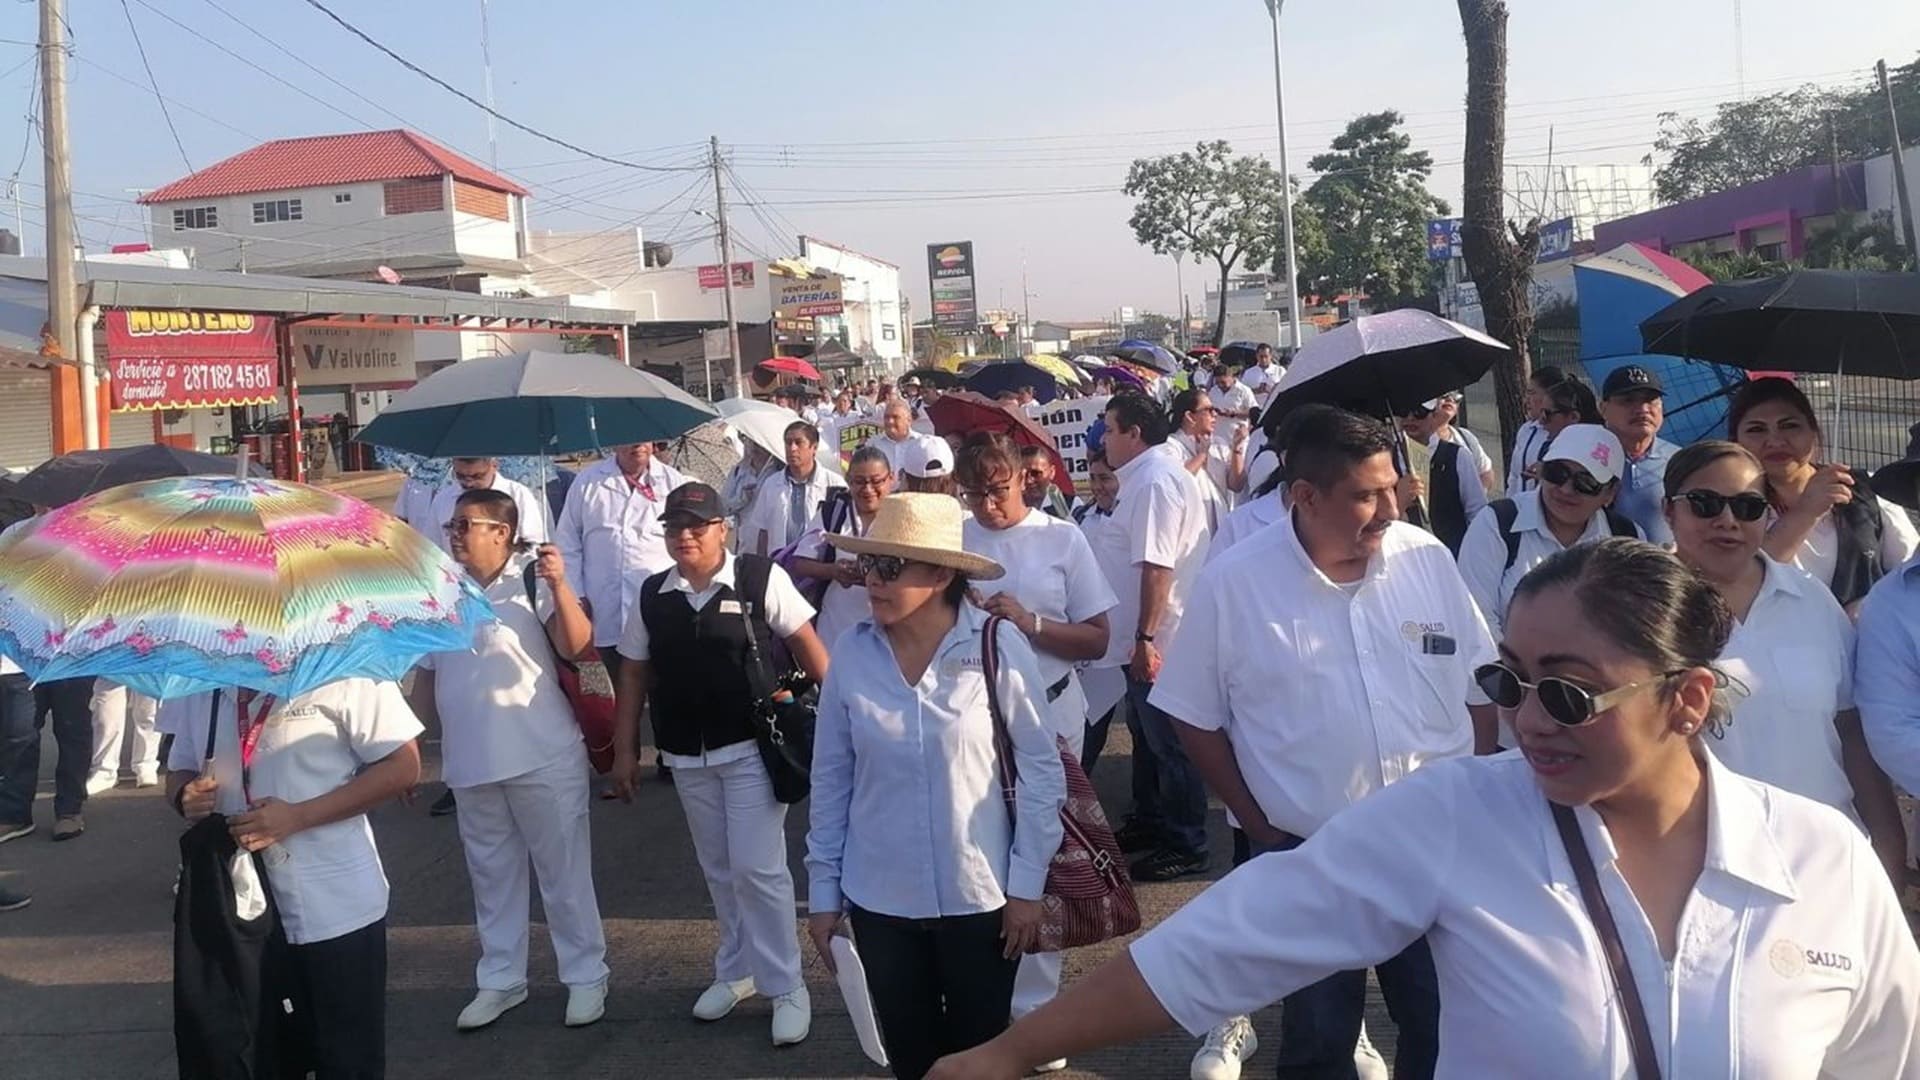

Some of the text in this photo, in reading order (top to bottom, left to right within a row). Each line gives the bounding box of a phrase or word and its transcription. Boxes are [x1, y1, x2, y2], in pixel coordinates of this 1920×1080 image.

[782, 285, 809, 293] VENTA
[328, 348, 398, 369] Valvoline
[117, 358, 164, 380] Servicio
[167, 364, 176, 379] a
[122, 380, 167, 400] domicilio
[1032, 408, 1082, 426] ión
[841, 423, 884, 441] SNTS
[1419, 621, 1446, 633] SALUD
[284, 707, 317, 717] SALUD
[1806, 949, 1852, 971] SALUD
